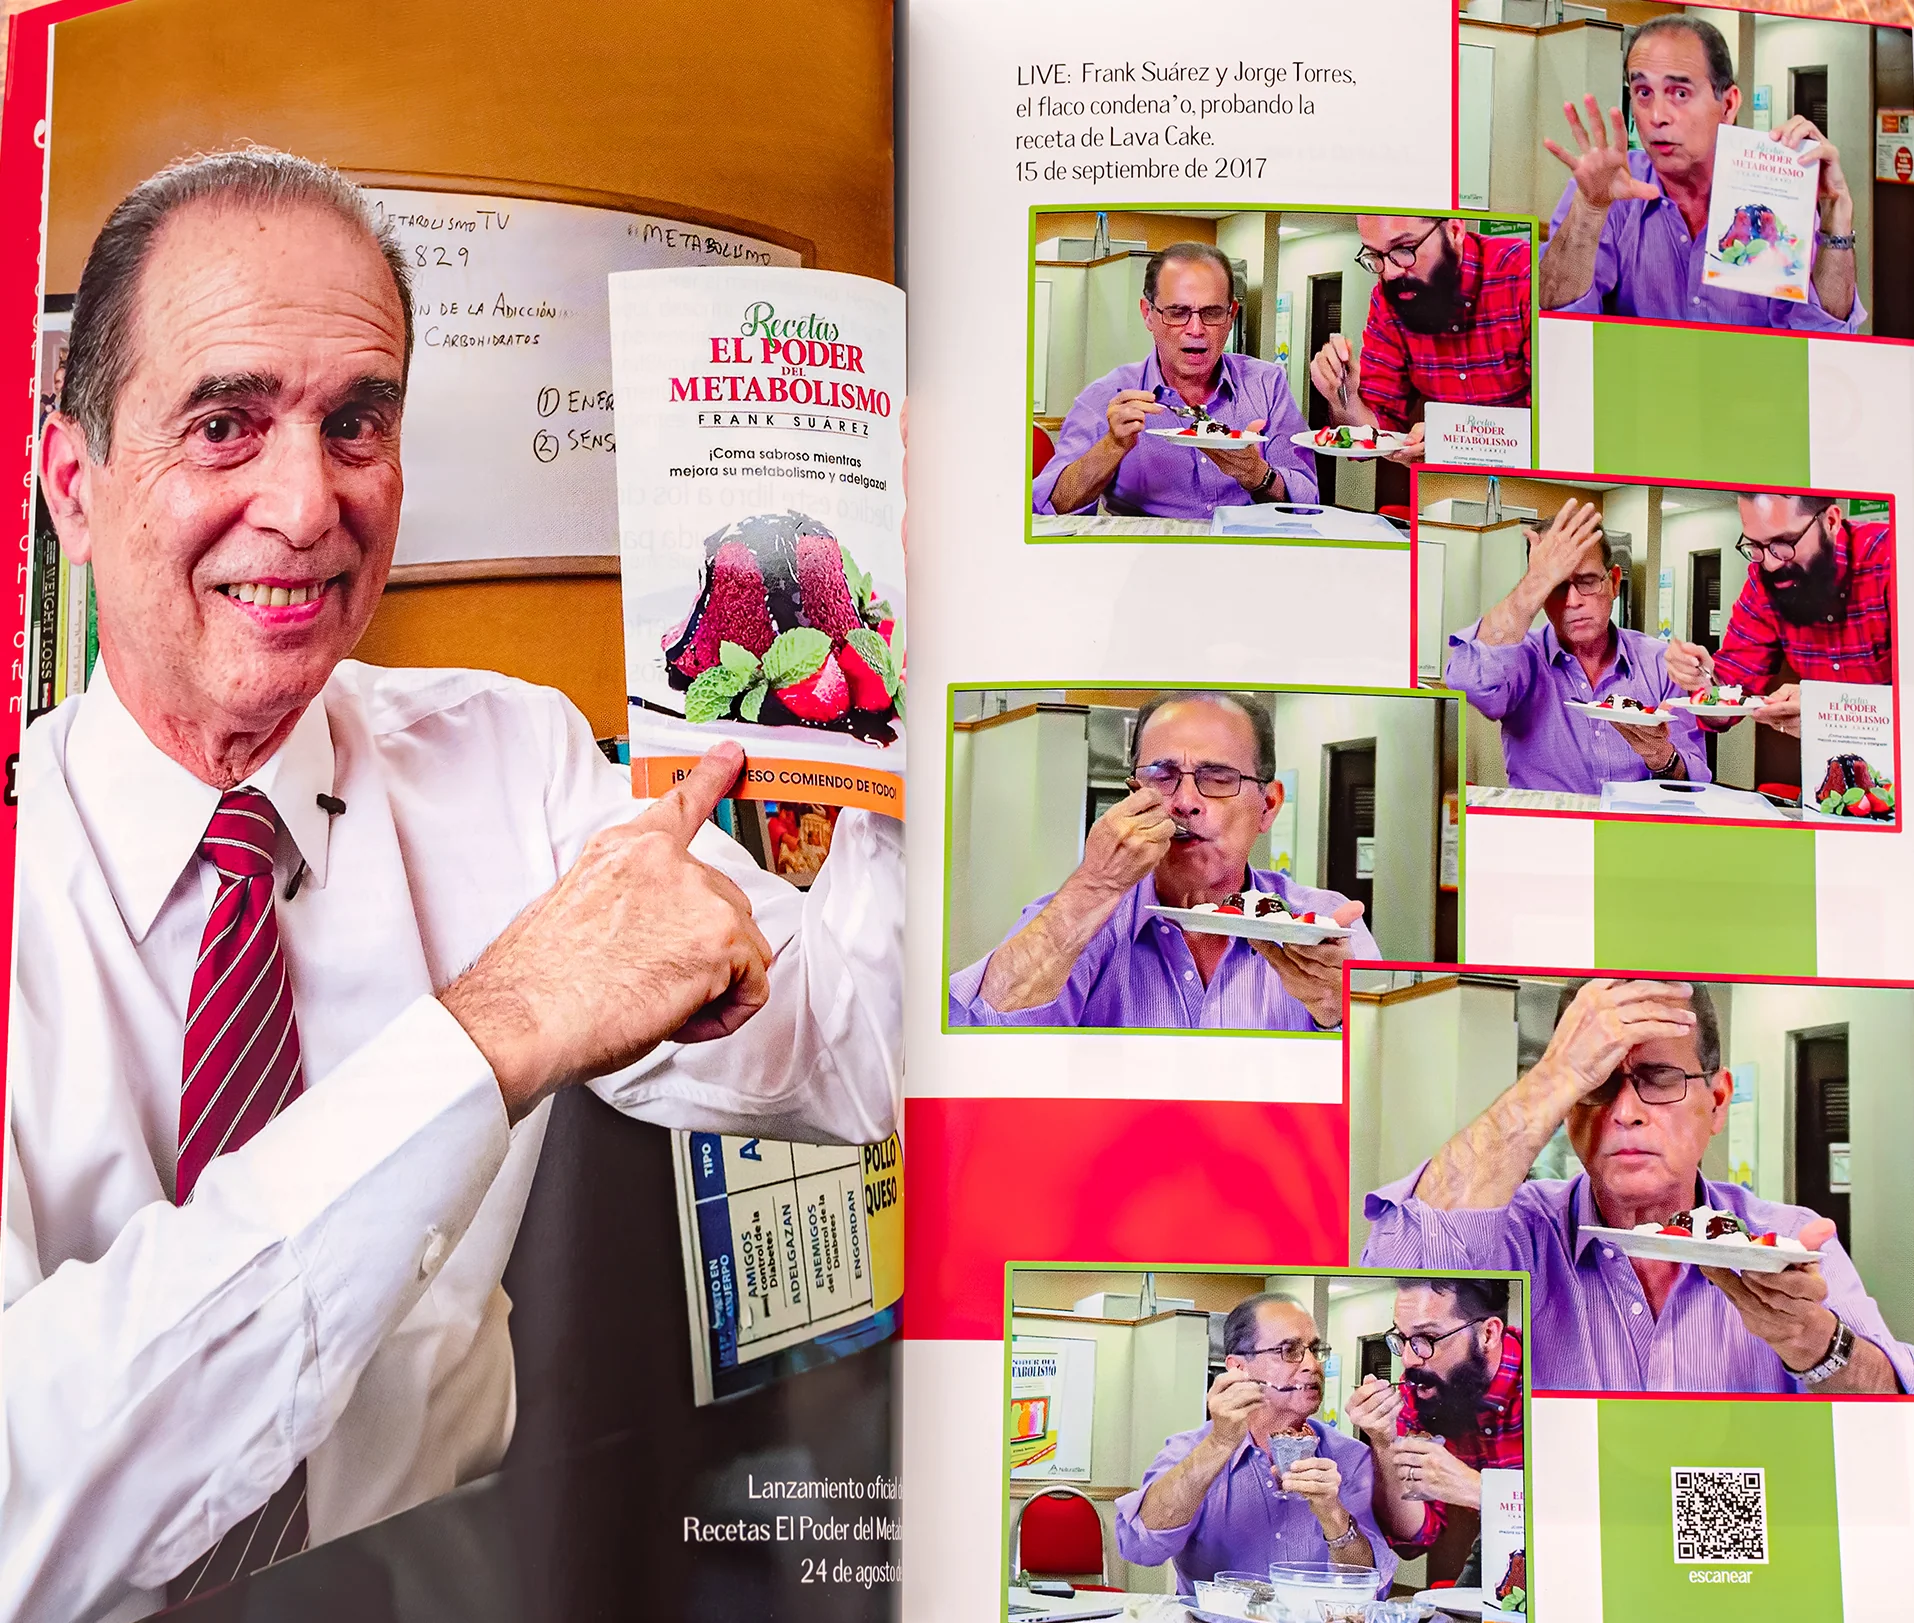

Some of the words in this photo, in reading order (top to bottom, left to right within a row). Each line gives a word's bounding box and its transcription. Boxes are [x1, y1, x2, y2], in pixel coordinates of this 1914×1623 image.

[1017, 64, 1072, 86] LIVE:
[1082, 62, 1136, 83] Frank
[1141, 61, 1209, 82] Suárez
[1216, 66, 1228, 87] y
[1233, 60, 1287, 88] Jorge
[1292, 61, 1357, 87] Torres,
[1016, 97, 1032, 118] el
[1037, 95, 1085, 117] flaco
[1200, 93, 1293, 119] probando
[1299, 94, 1315, 115] la
[1016, 130, 1075, 150] receta
[1080, 127, 1104, 148] de
[1109, 126, 1159, 147] Lava
[1164, 125, 1215, 147] Cake.
[1732, 159, 1804, 178] METABOLISMO
[1744, 149, 1756, 158] EL
[1759, 152, 1792, 165] PODER
[1015, 161, 1038, 182] 15
[1044, 160, 1067, 180] de
[1072, 157, 1180, 185] septiembre
[1185, 157, 1208, 178] de
[1214, 157, 1267, 179] 2017
[477, 211, 510, 230] TV
[415, 245, 469, 267] 829
[440, 303, 458, 316] DE
[468, 302, 484, 316] LA
[740, 301, 840, 348] Recetas
[709, 337, 753, 364] EL
[761, 337, 865, 374] PODER
[781, 366, 806, 377] DEL
[668, 376, 891, 418] METABOLISMO
[699, 414, 774, 426] FRANK
[794, 416, 869, 436] SUÁREZ
[1455, 424, 1468, 432] EL
[1470, 426, 1505, 435] PODER
[1443, 434, 1518, 447] METABOLISMO
[709, 448, 755, 461] ¡Coma
[759, 448, 810, 462] sabroso
[813, 452, 862, 468] mientras
[669, 466, 718, 479] mejora
[722, 467, 737, 476] su
[741, 466, 826, 480] metabolismo
[829, 472, 836, 484] y
[839, 471, 887, 491] adelgaza!
[43, 566, 56, 634] WEIGHT
[42, 639, 53, 679] LOSS
[1818, 712, 1890, 725] METABOLISMO
[1829, 702, 1842, 711] EL
[1844, 704, 1877, 713] PODER
[743, 769, 775, 783] ESO
[779, 771, 853, 790] COMIENDO
[856, 779, 870, 793] DE
[872, 782, 897, 799] TODO!
[701, 1143, 714, 1178] TIPO
[739, 1138, 762, 1162] A
[864, 1138, 896, 1175] POLLO
[818, 1194, 826, 1206] la
[865, 1176, 897, 1217] QUESO
[752, 1210, 760, 1223] la
[820, 1208, 827, 1223] de
[754, 1225, 762, 1241] de
[829, 1213, 841, 1269] Diabetes
[847, 1190, 862, 1280] ENGORDAN
[781, 1204, 801, 1304] ADELGAZAN
[807, 1204, 825, 1288] ENEMIGOS
[821, 1226, 833, 1271] control
[709, 1258, 720, 1278] EN
[741, 1231, 759, 1298] AMIGOS
[755, 1244, 769, 1290] control
[766, 1230, 778, 1288] Diabetes
[826, 1273, 835, 1294] del
[749, 1474, 864, 1499] Lanzamiento
[867, 1475, 898, 1499] oficial
[684, 1516, 770, 1542] Recetas
[776, 1516, 794, 1541] El
[800, 1516, 849, 1541] Poder
[853, 1516, 873, 1540] del
[801, 1558, 827, 1584] 24
[833, 1559, 852, 1583] de
[855, 1562, 895, 1590] agosto
[1689, 1571, 1753, 1583] escanear
